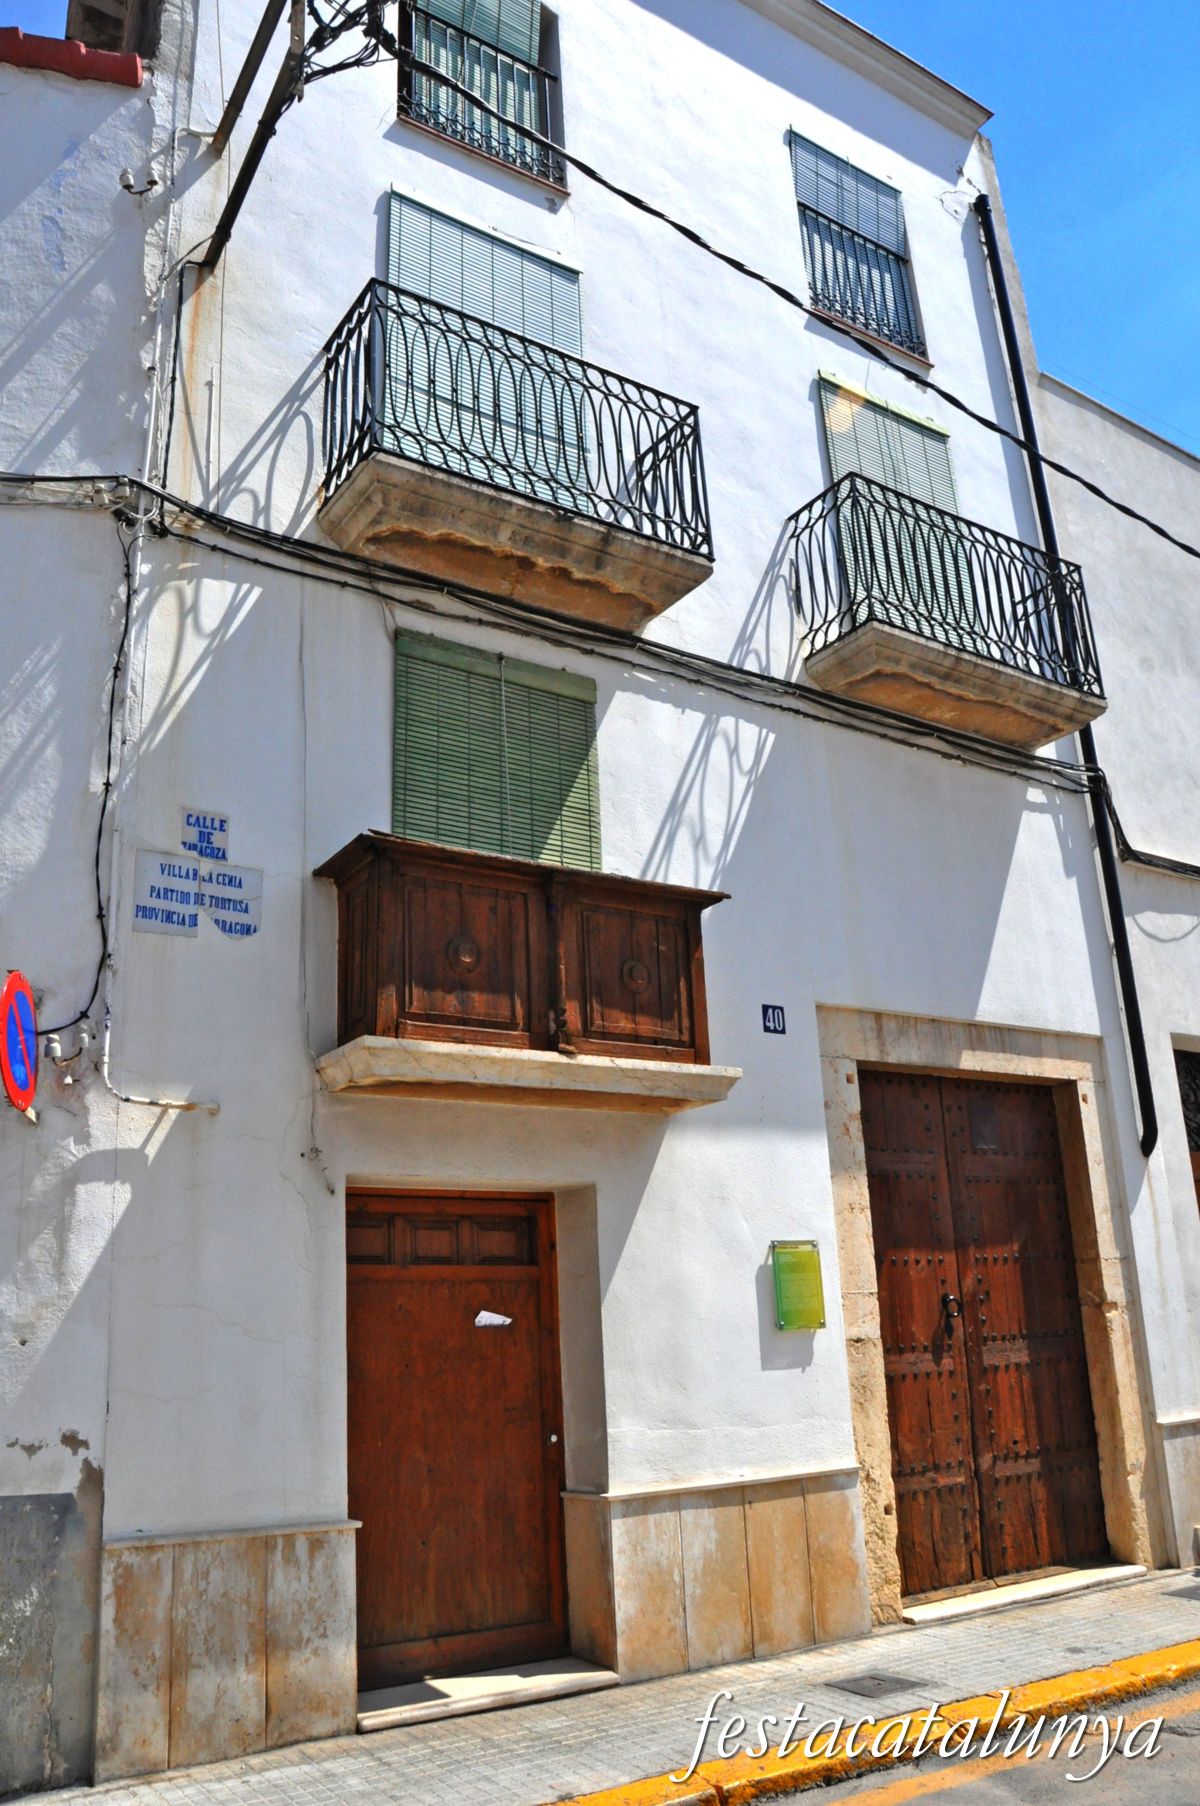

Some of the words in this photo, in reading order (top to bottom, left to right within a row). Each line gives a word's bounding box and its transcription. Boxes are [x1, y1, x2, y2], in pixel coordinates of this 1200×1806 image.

[186, 814, 227, 832] CALLE
[198, 830, 214, 845] DE
[160, 863, 190, 880] VILLA
[216, 873, 243, 889] CENIA
[149, 885, 191, 905] PARTIDO
[193, 892, 206, 906] DE
[208, 895, 249, 914] TORTOSA
[135, 905, 186, 926] PROVINCIA
[188, 913, 198, 928] DE
[765, 1008, 784, 1031] 40
